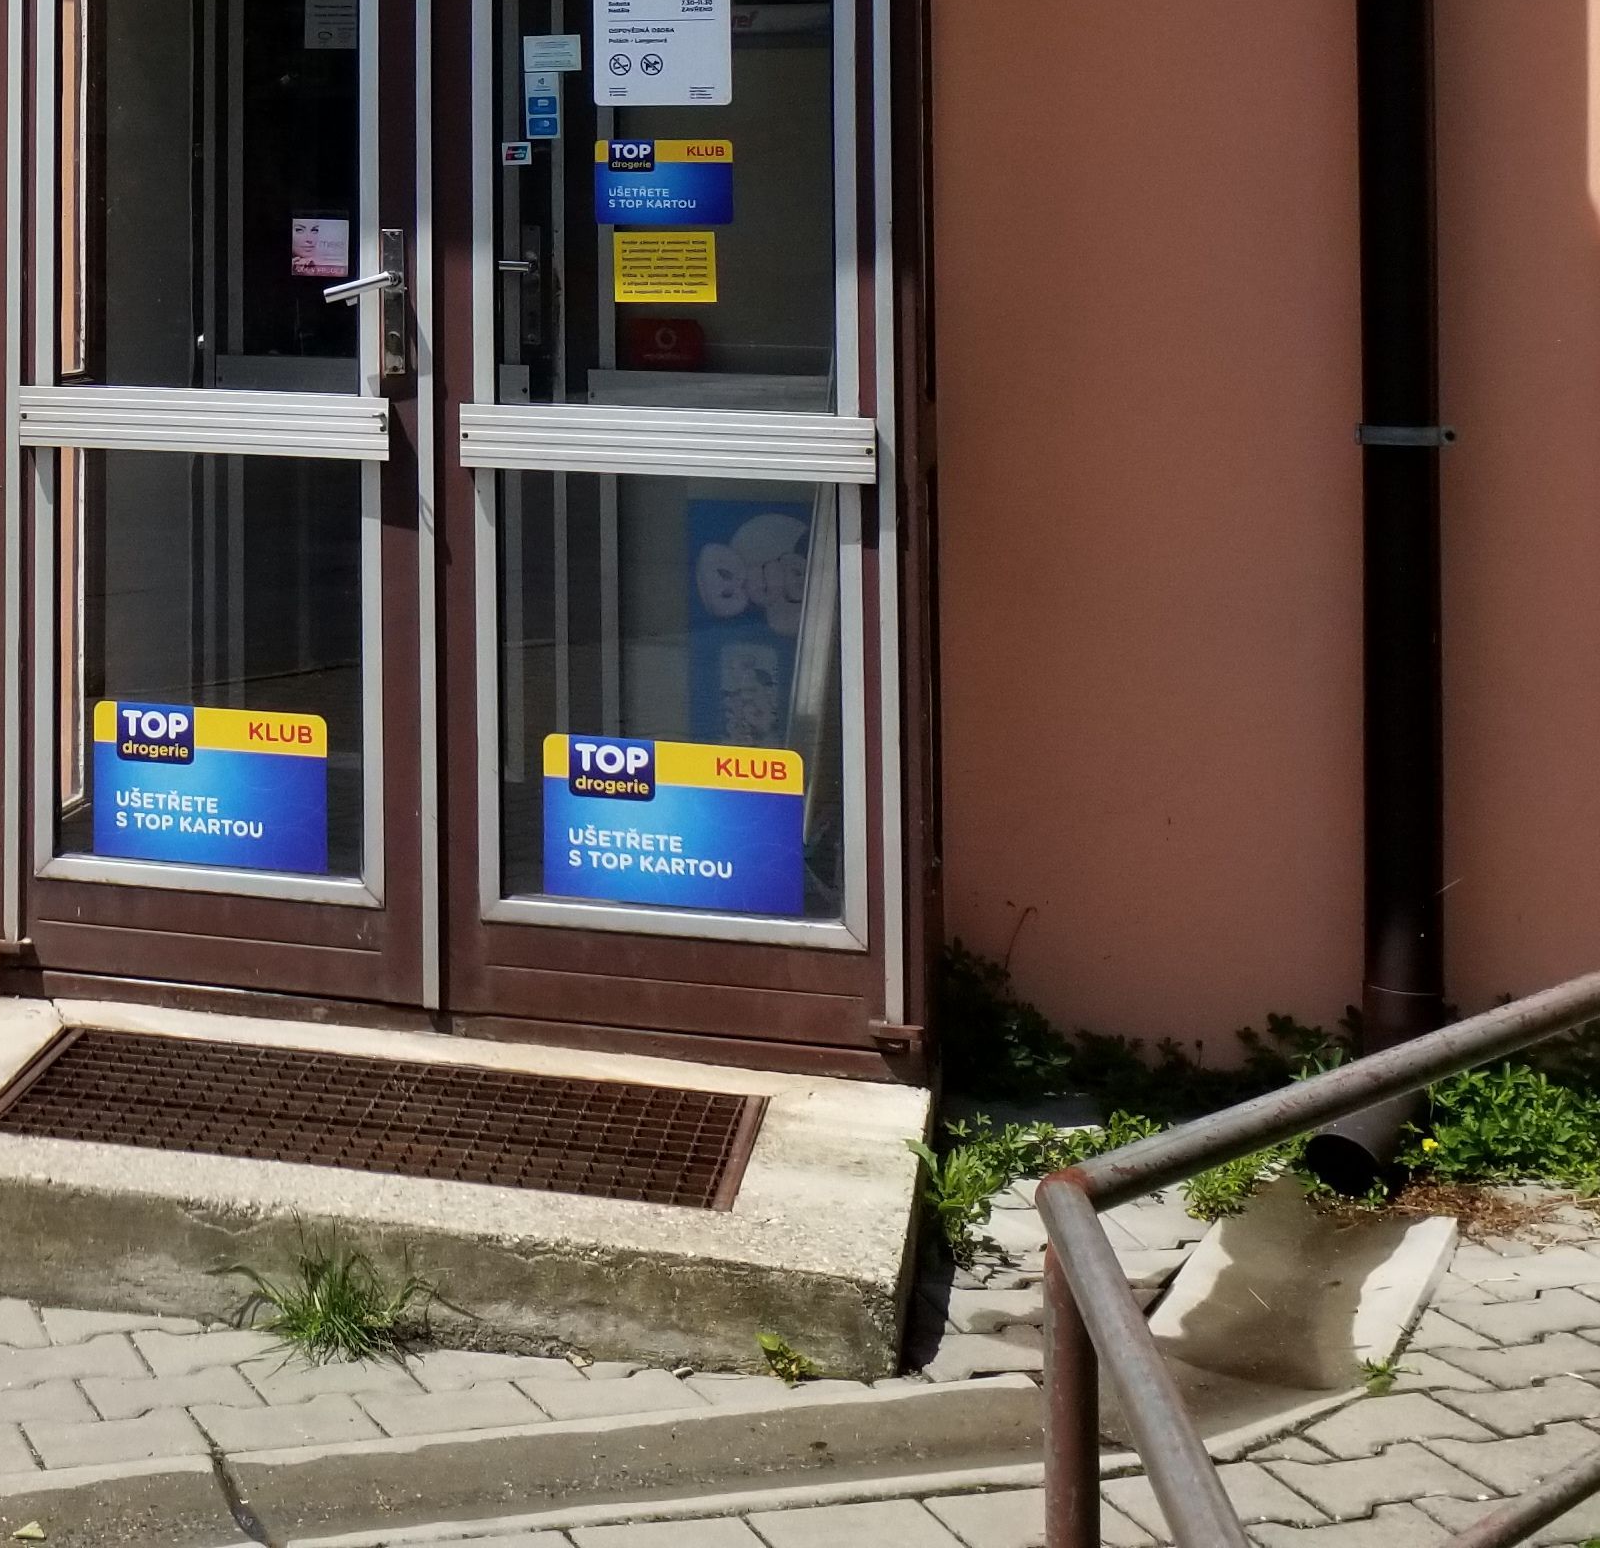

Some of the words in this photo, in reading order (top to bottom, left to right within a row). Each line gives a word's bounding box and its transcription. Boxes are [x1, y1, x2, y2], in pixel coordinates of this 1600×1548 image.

[611, 143, 652, 159] TOP
[686, 145, 726, 157] KLUB
[611, 160, 652, 170] drogerie
[608, 185, 670, 198] UŠETŘETE
[608, 199, 616, 209] S
[620, 199, 643, 209] TOP
[646, 199, 697, 209] KARTOU
[121, 708, 189, 740] TOP
[248, 721, 313, 744] KLUB
[121, 740, 189, 759] drogerie
[574, 742, 650, 777] TOP
[715, 756, 788, 781] KLUB
[574, 775, 650, 796] drogerie
[115, 787, 219, 815] UŠETŘETE
[115, 811, 128, 828] S
[133, 812, 174, 832] TOP
[179, 816, 264, 839] KARTOU
[568, 824, 683, 854] UŠETŘETE
[568, 849, 583, 867] S
[589, 850, 633, 872] TOP
[639, 855, 733, 880] KARTOU
